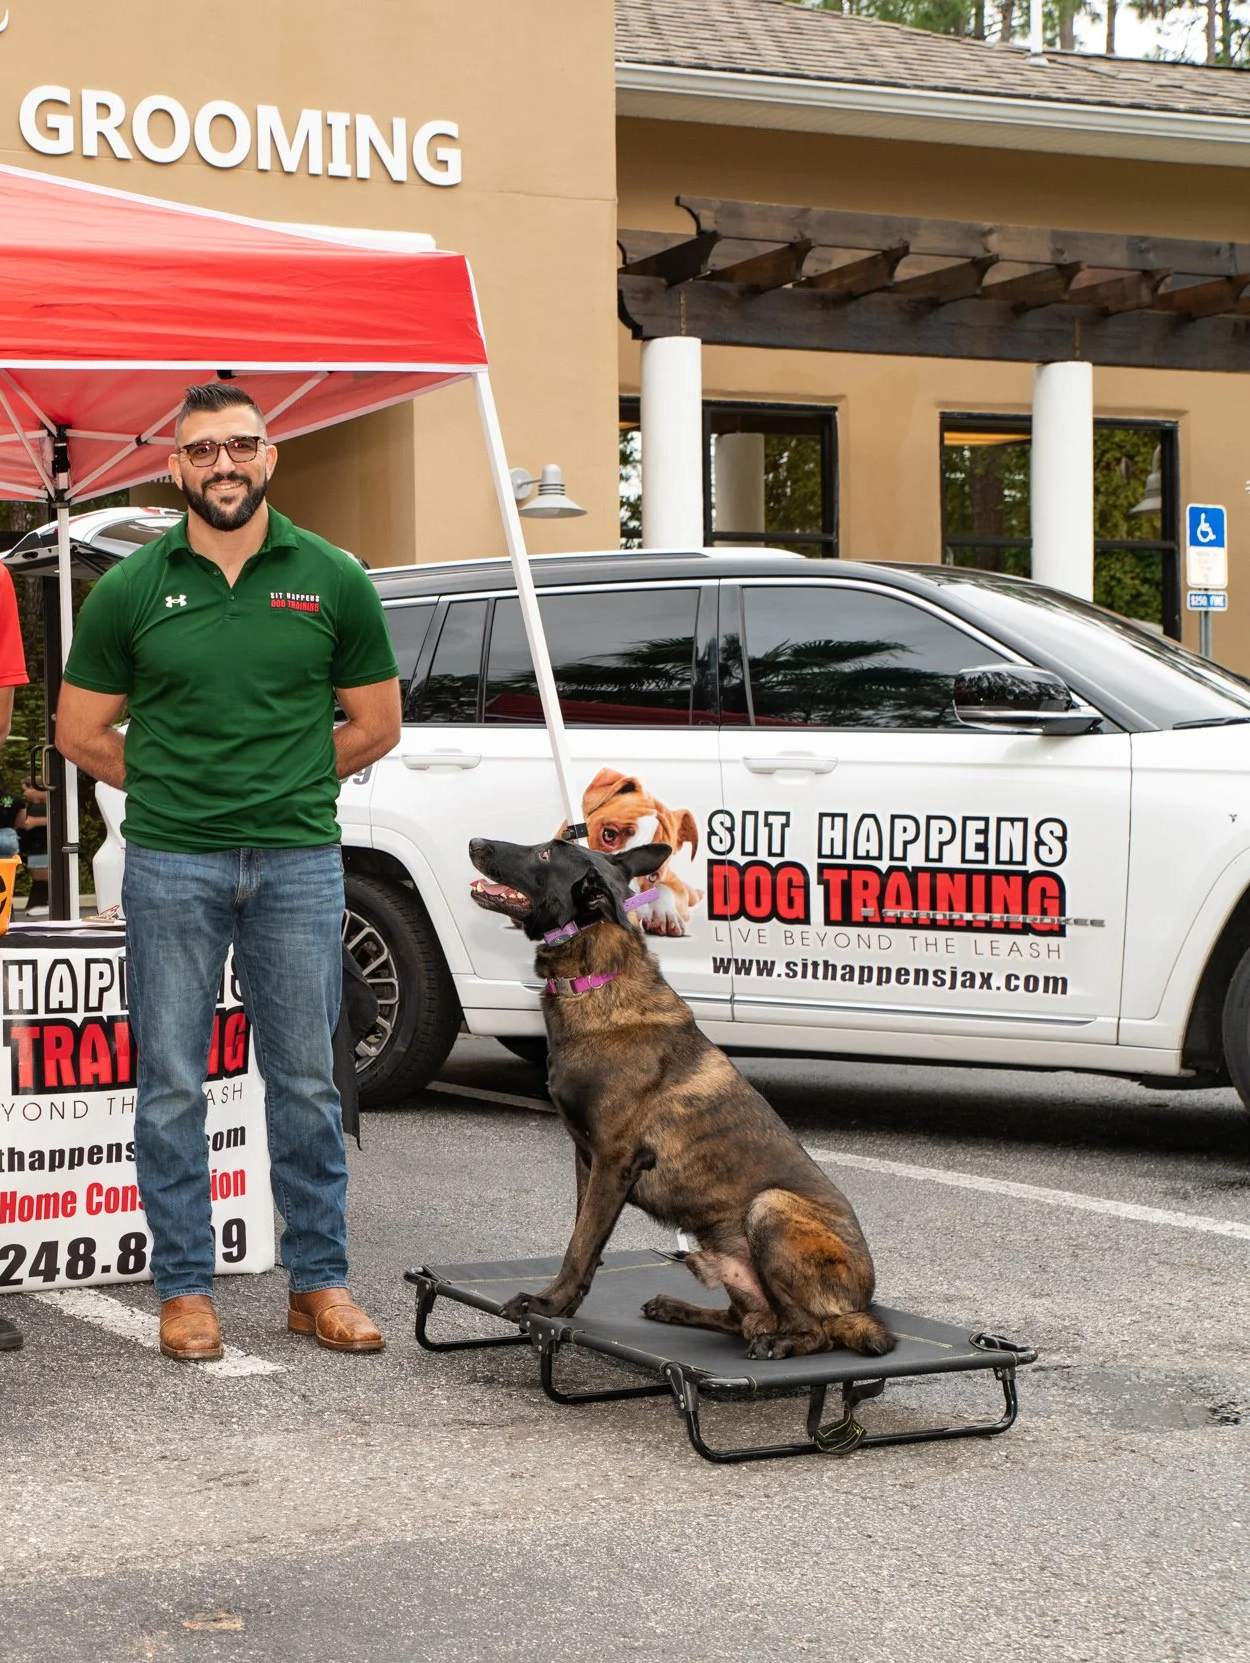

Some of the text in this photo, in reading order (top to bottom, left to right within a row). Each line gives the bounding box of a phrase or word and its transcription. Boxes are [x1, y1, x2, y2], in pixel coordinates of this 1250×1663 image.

[19, 84, 461, 186] GROOMING
[270, 591, 320, 603] SIT HAPPENS
[707, 809, 1068, 868] SIT HAPPENS
[707, 859, 1067, 938] DOG TRAINING
[784, 930, 892, 950] BEYOND
[909, 936, 956, 954] THE
[974, 939, 1061, 960] LEASH
[712, 956, 1068, 995] www.sithappensjax.com
[3, 1004, 251, 1096] TRAIG
[107, 1095, 135, 1116] TH
[205, 1082, 243, 1106] ASH
[0, 1190, 78, 1224] Home
